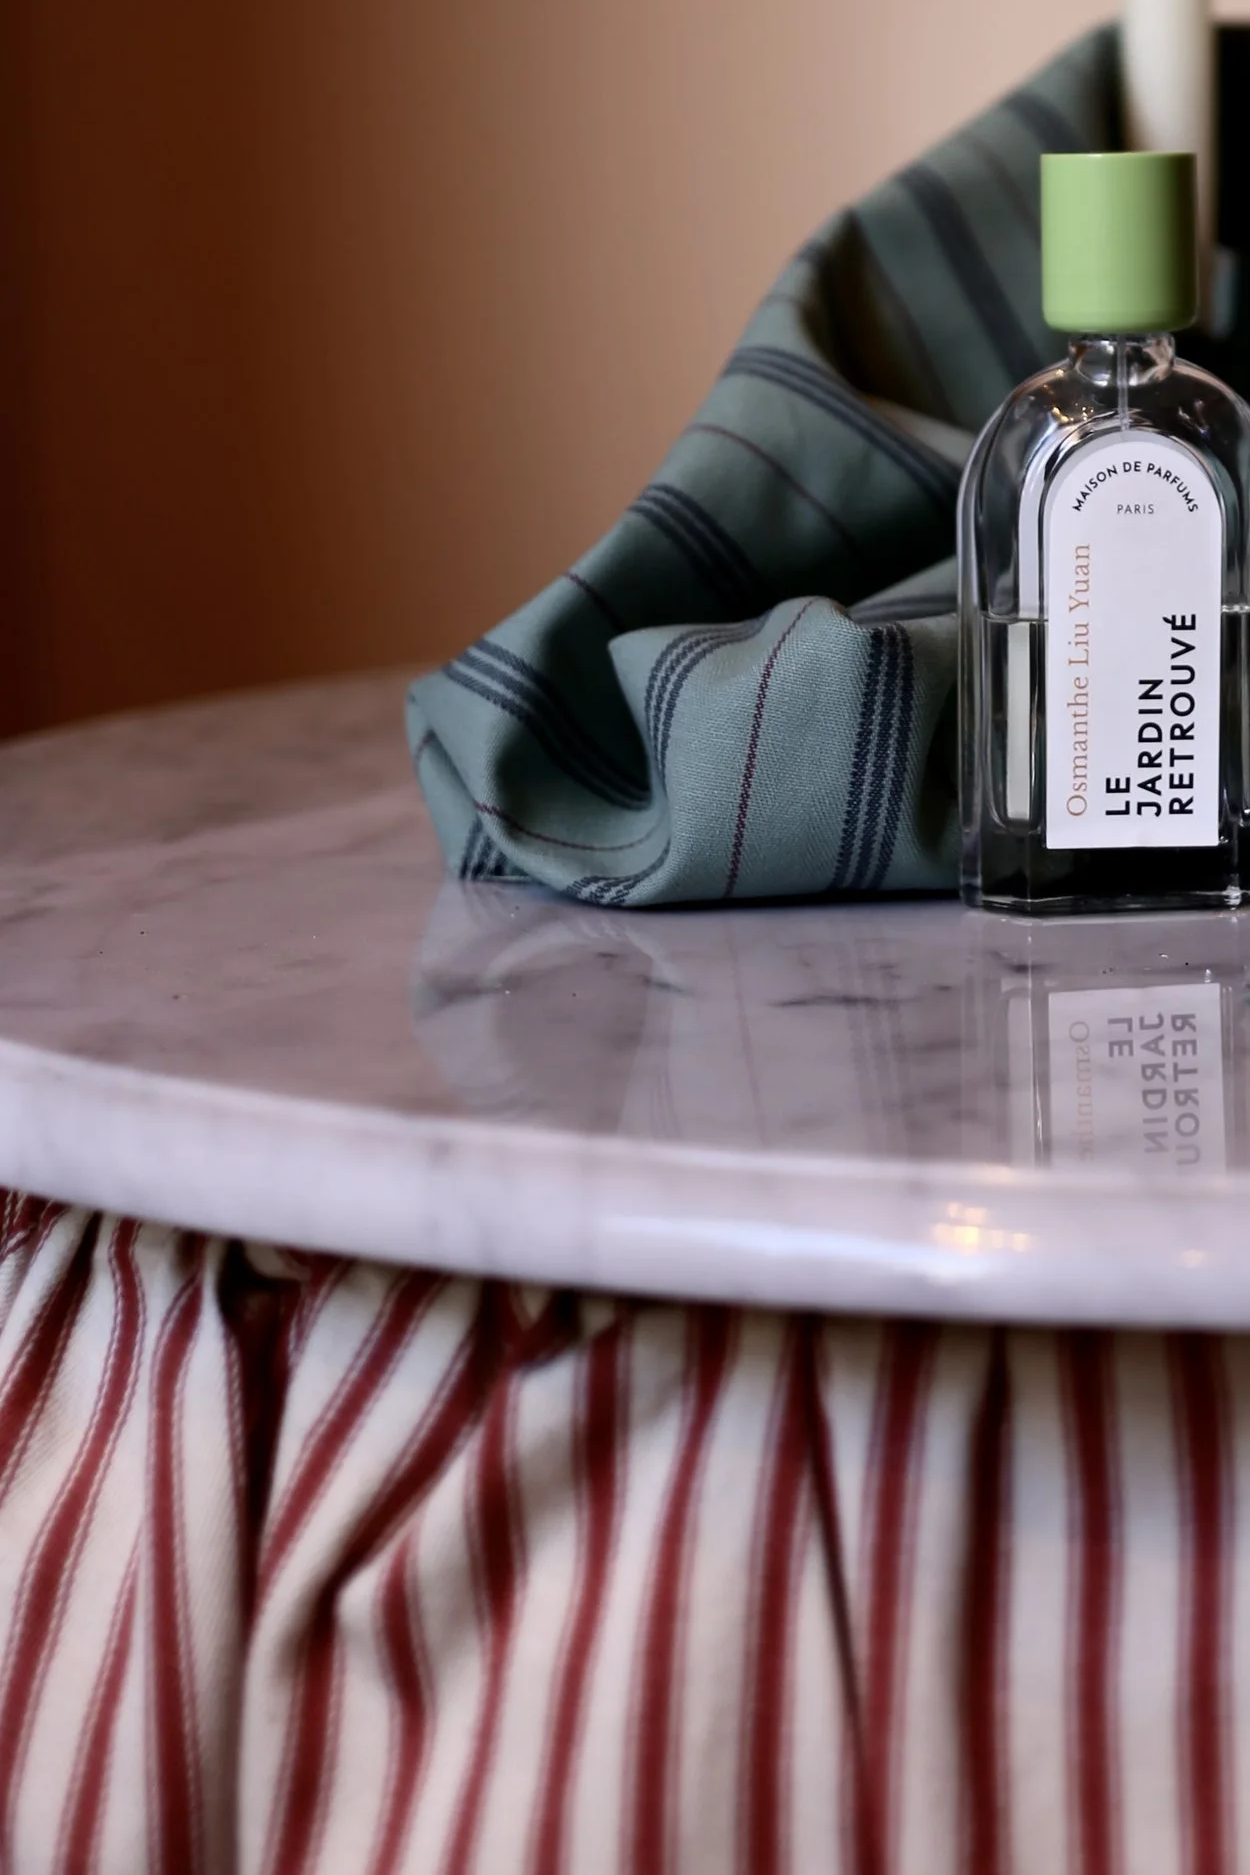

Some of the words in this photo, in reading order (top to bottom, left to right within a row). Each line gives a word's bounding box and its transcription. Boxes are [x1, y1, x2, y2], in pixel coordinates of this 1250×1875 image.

[1072, 465, 1118, 512] MAISON
[1122, 461, 1142, 473] DE
[1147, 463, 1199, 512] PARFUMS
[1116, 504, 1155, 515] PARIS
[1068, 543, 1090, 613] Yuan
[1068, 621, 1090, 667] Liu
[1163, 613, 1197, 816] RETROUVÉ
[1066, 676, 1090, 817] Osmanthe
[1137, 679, 1164, 817] JARDIN
[1105, 776, 1130, 817] LE
